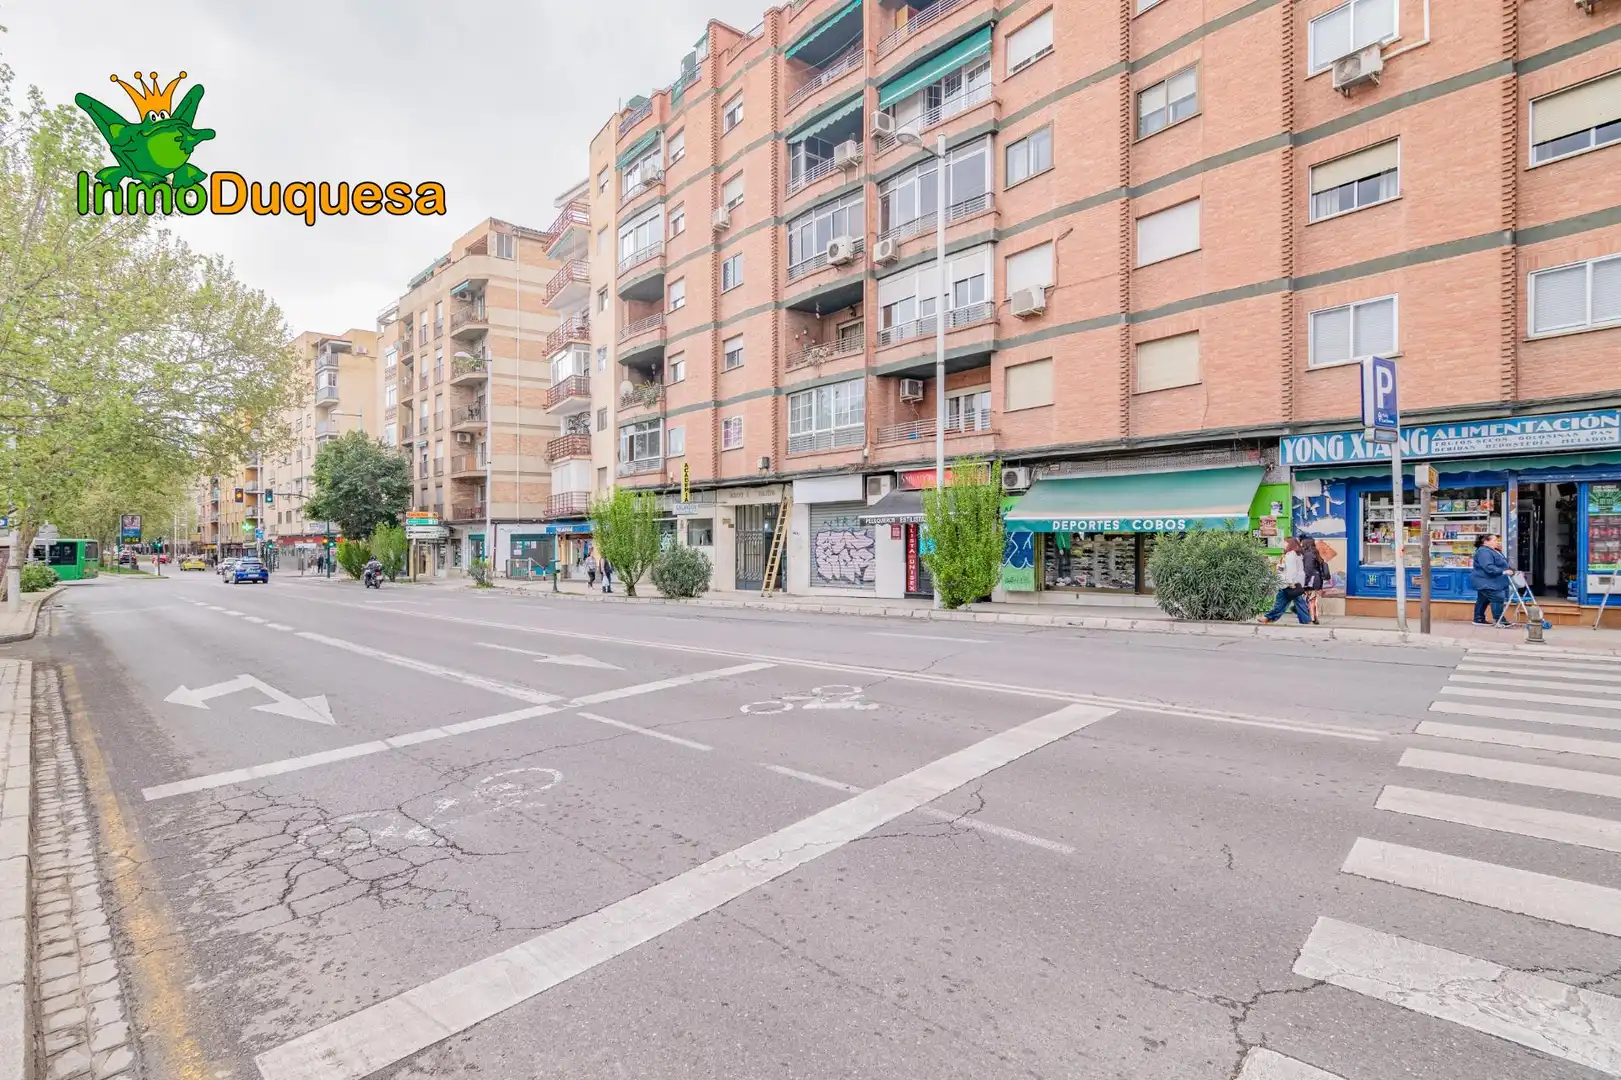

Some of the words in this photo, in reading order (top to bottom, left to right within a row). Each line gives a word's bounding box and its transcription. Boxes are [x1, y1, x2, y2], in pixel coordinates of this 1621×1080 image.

[1376, 366, 1393, 409] P
[1432, 414, 1619, 440] ALIMENTACIÓN
[1283, 435, 1344, 463] YONG
[1052, 520, 1119, 531] DEPORTES
[1132, 519, 1186, 530] COBOS
